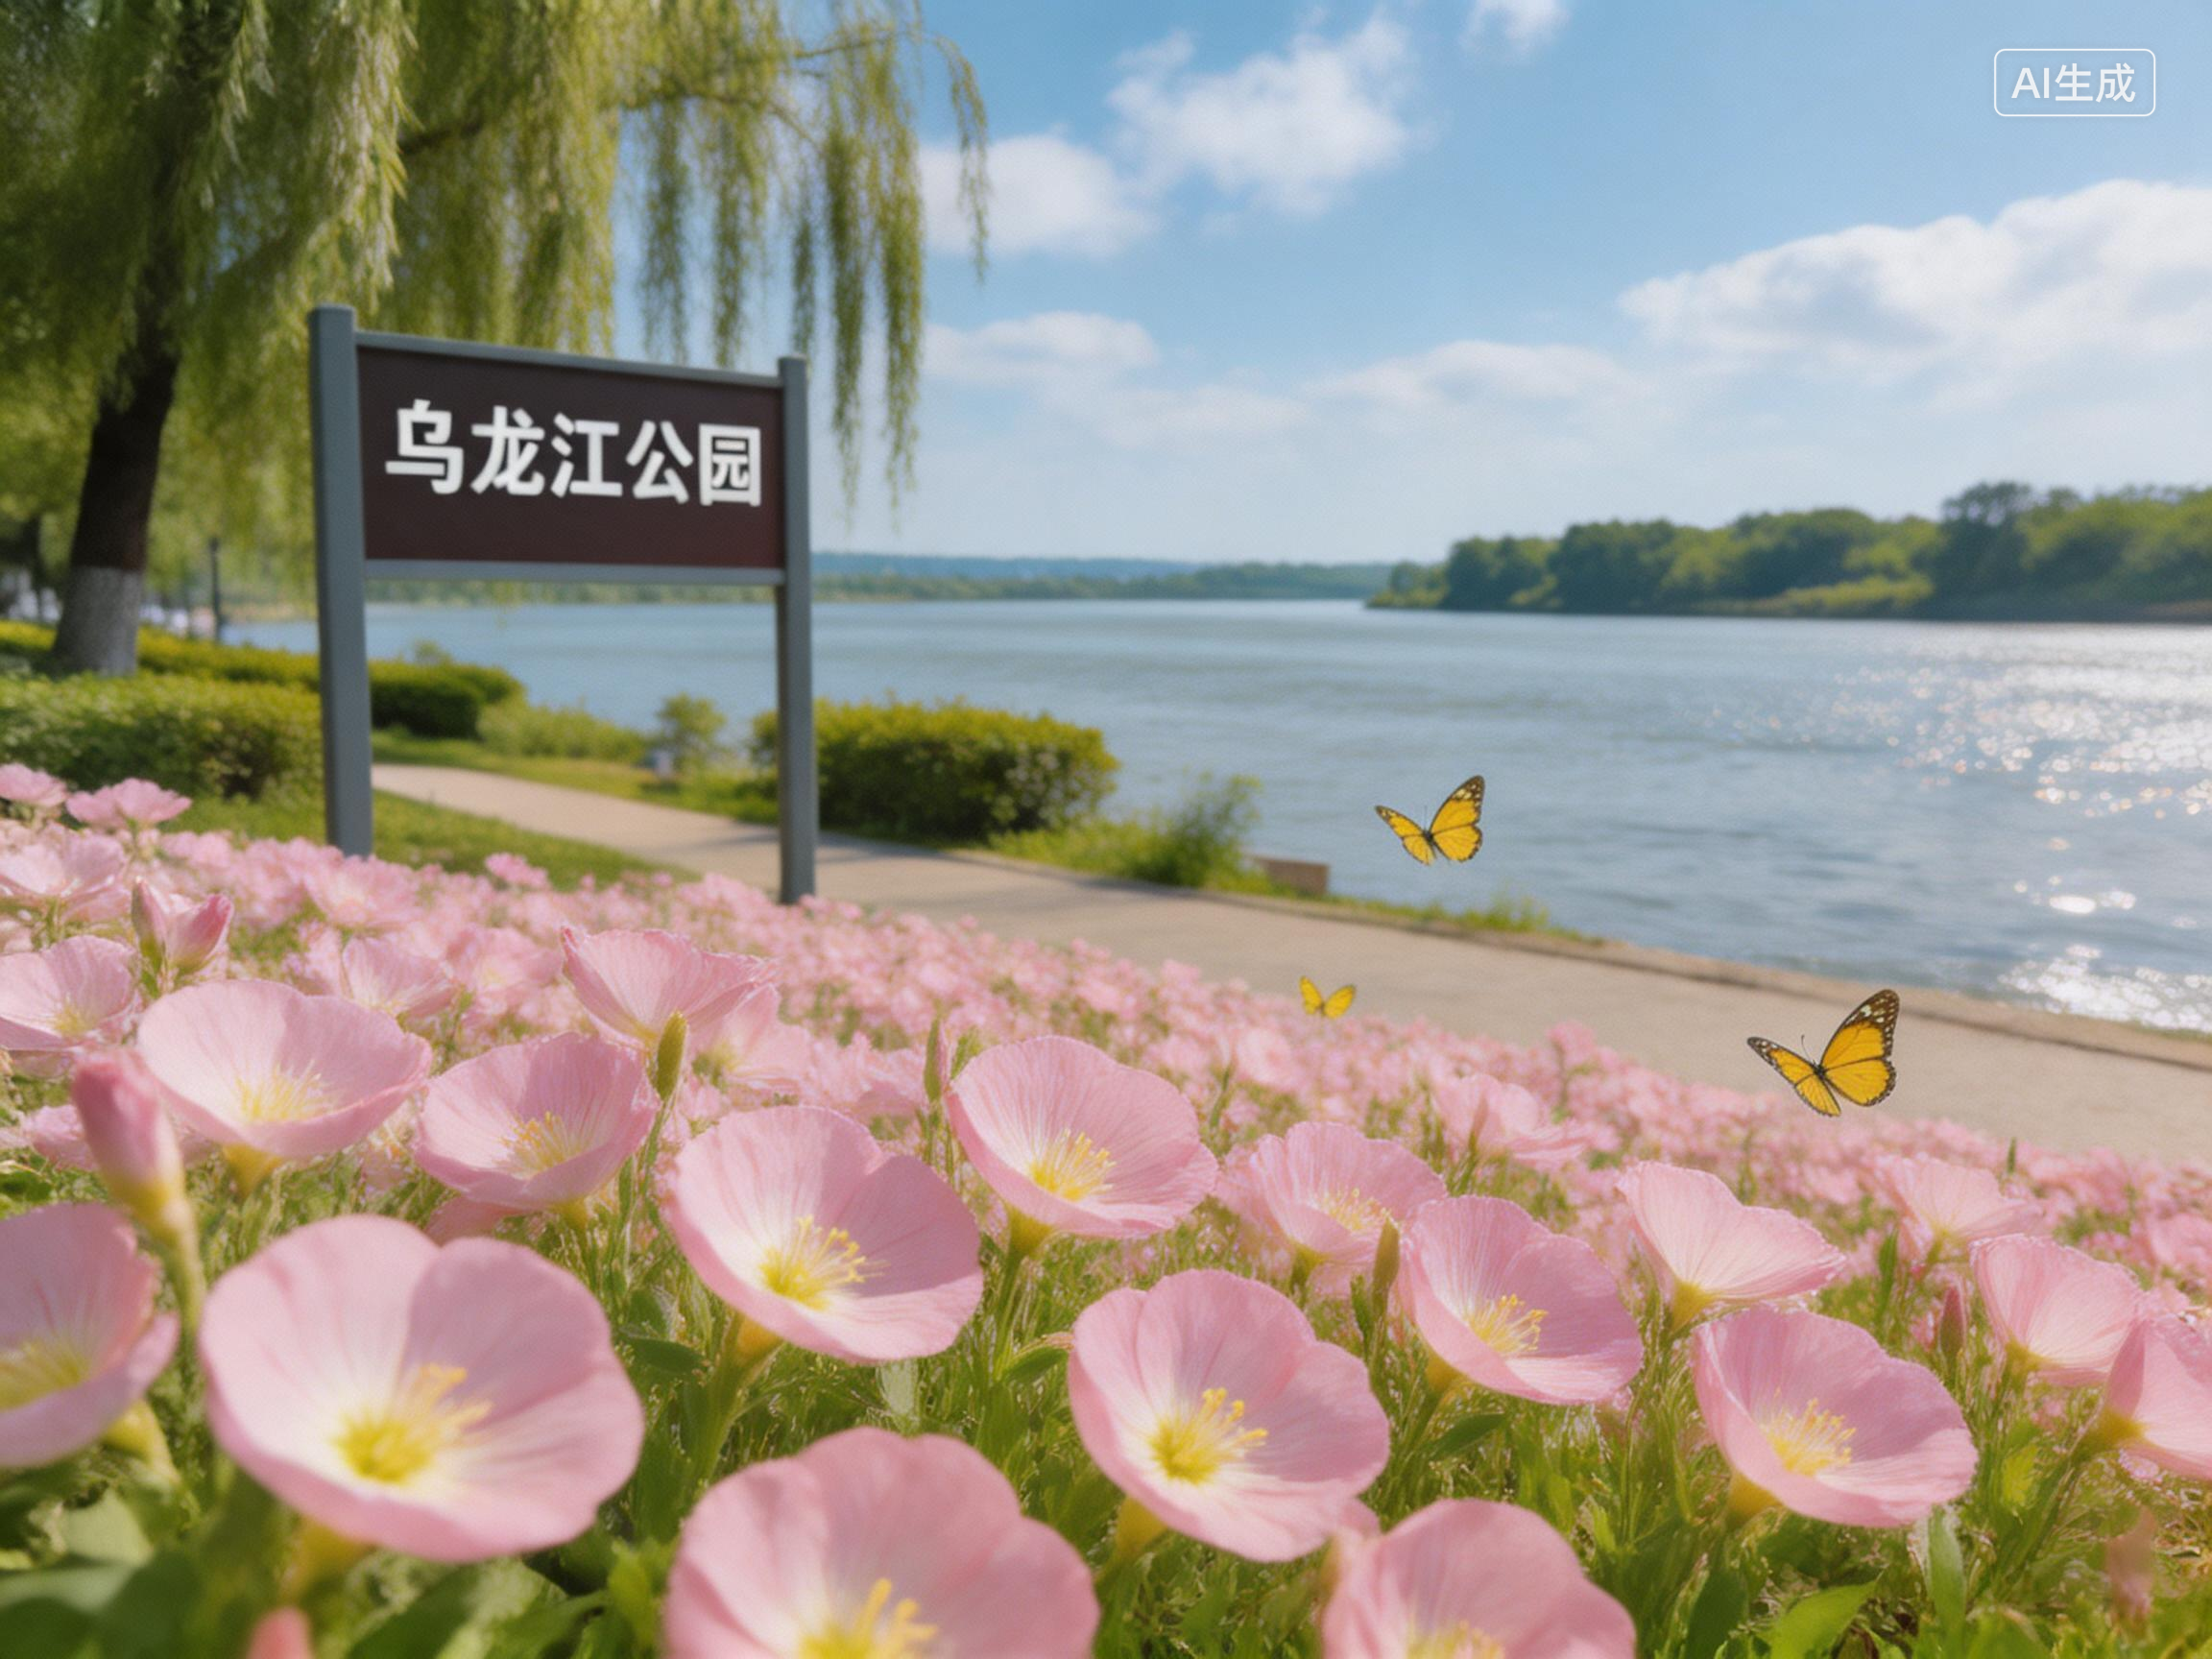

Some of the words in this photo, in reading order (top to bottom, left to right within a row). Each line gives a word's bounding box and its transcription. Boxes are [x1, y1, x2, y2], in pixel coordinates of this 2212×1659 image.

[385, 398, 761, 507] 乌龙江公园
